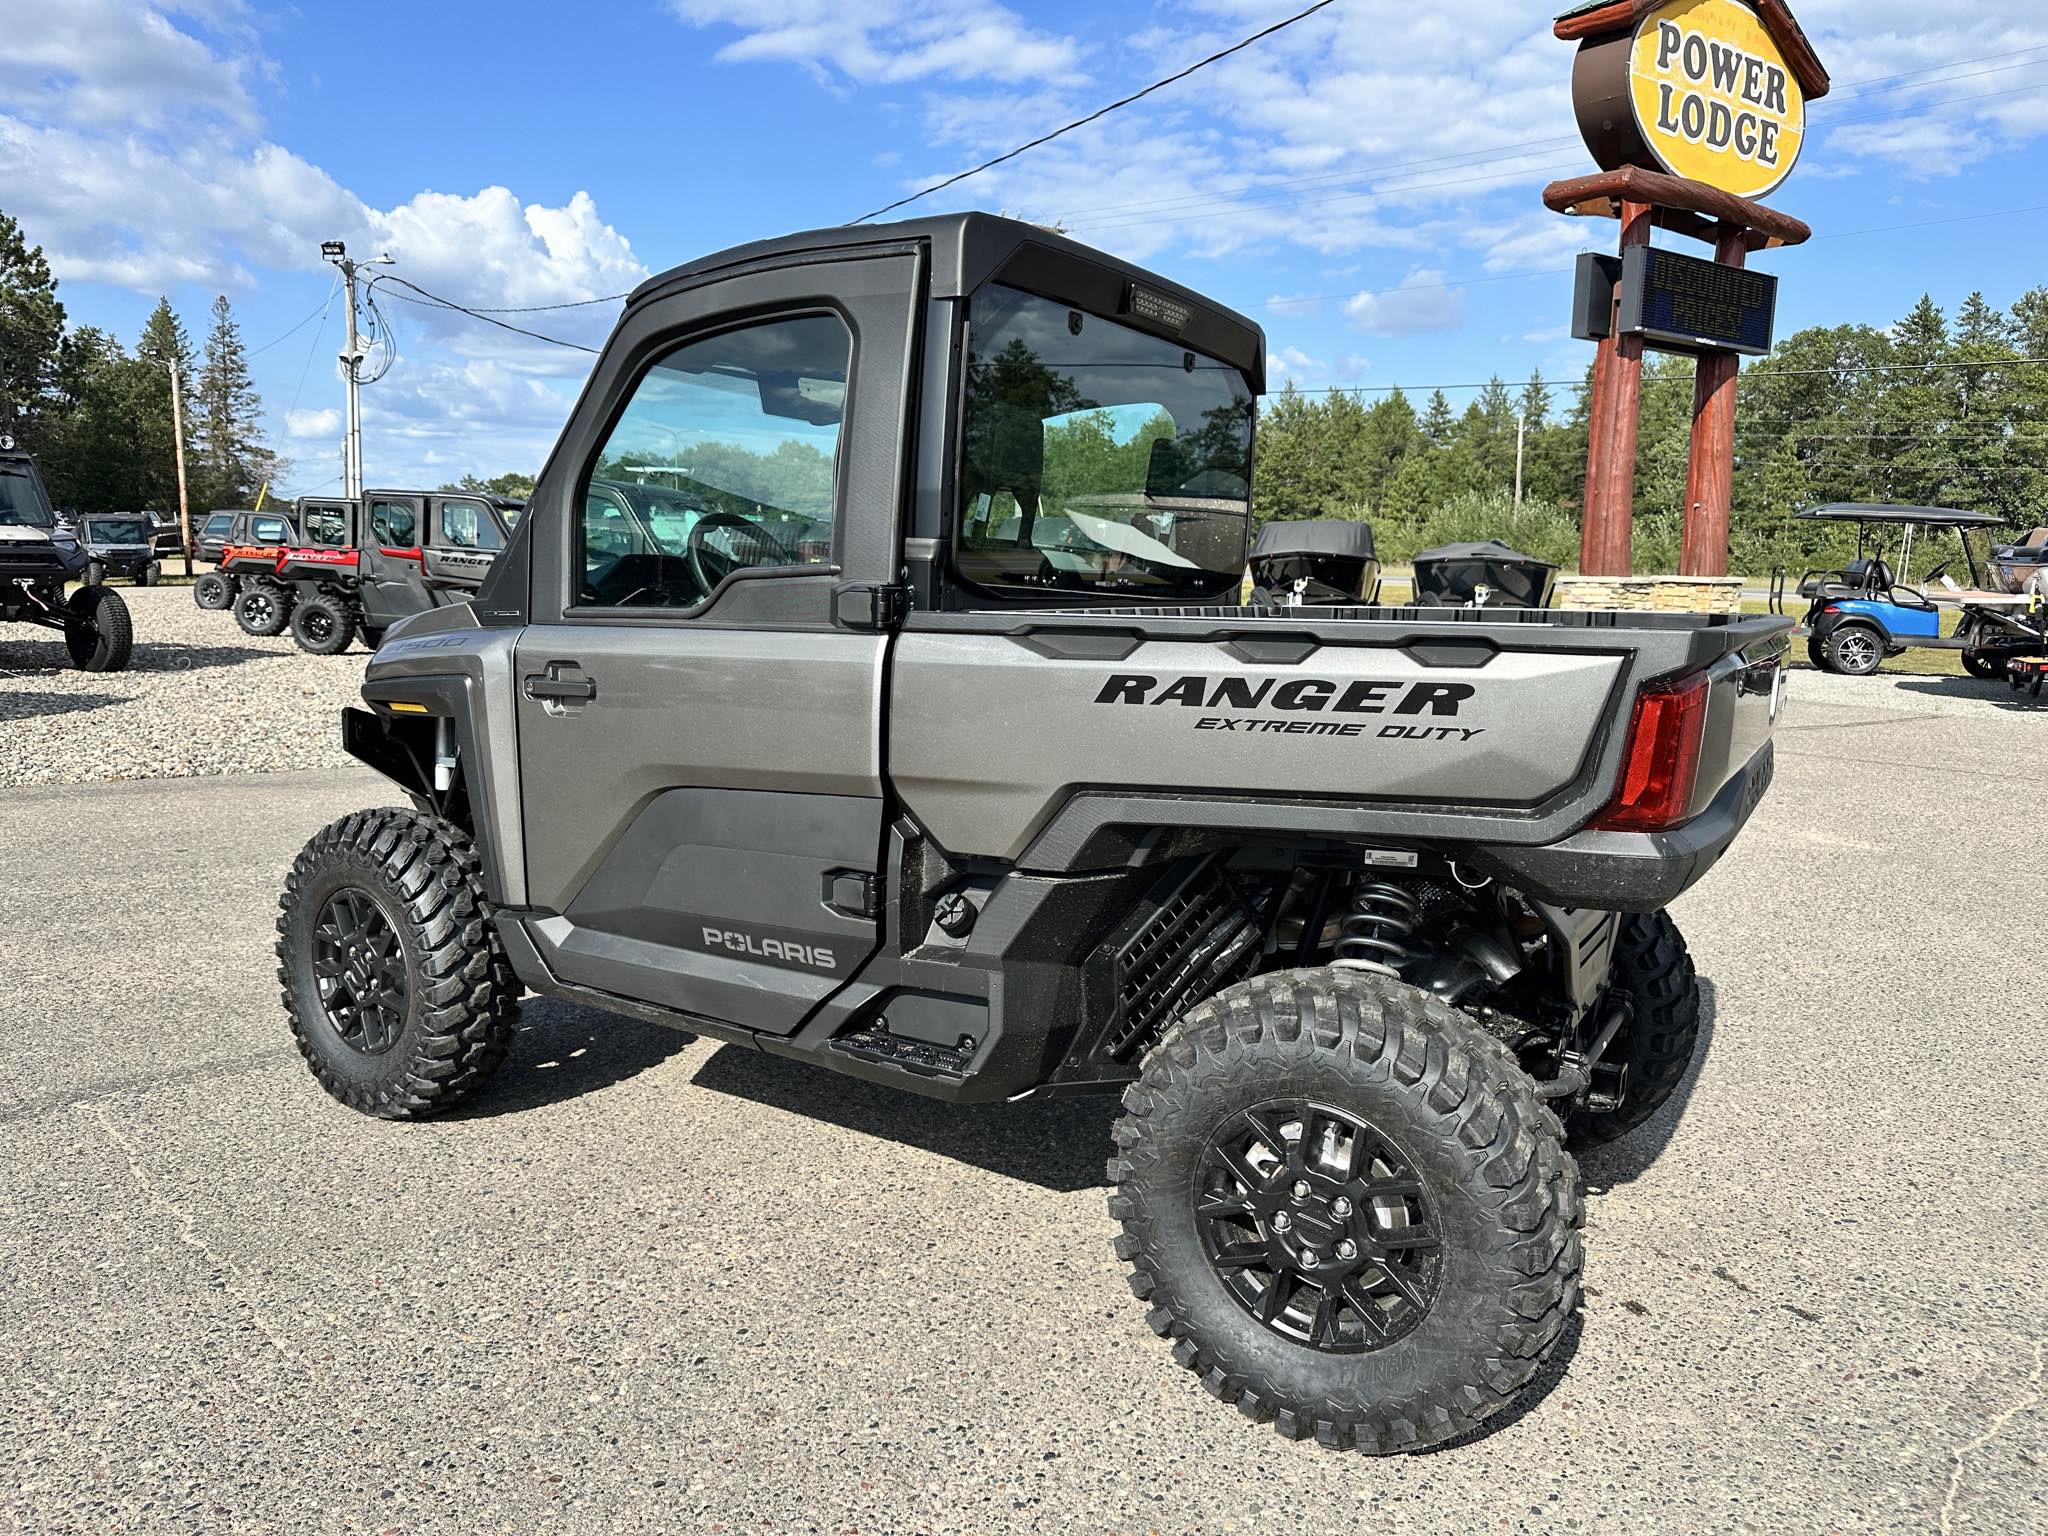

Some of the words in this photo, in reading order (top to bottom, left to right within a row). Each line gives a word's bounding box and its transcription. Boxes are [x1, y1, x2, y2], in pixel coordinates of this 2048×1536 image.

[1657, 22, 1785, 114] POWER
[1658, 84, 1778, 165] LODGE
[1094, 674, 1476, 716] RANGER
[1193, 717, 1367, 736] EXTREME
[1376, 725, 1487, 742] DUTY
[702, 927, 836, 969] POLARIS
